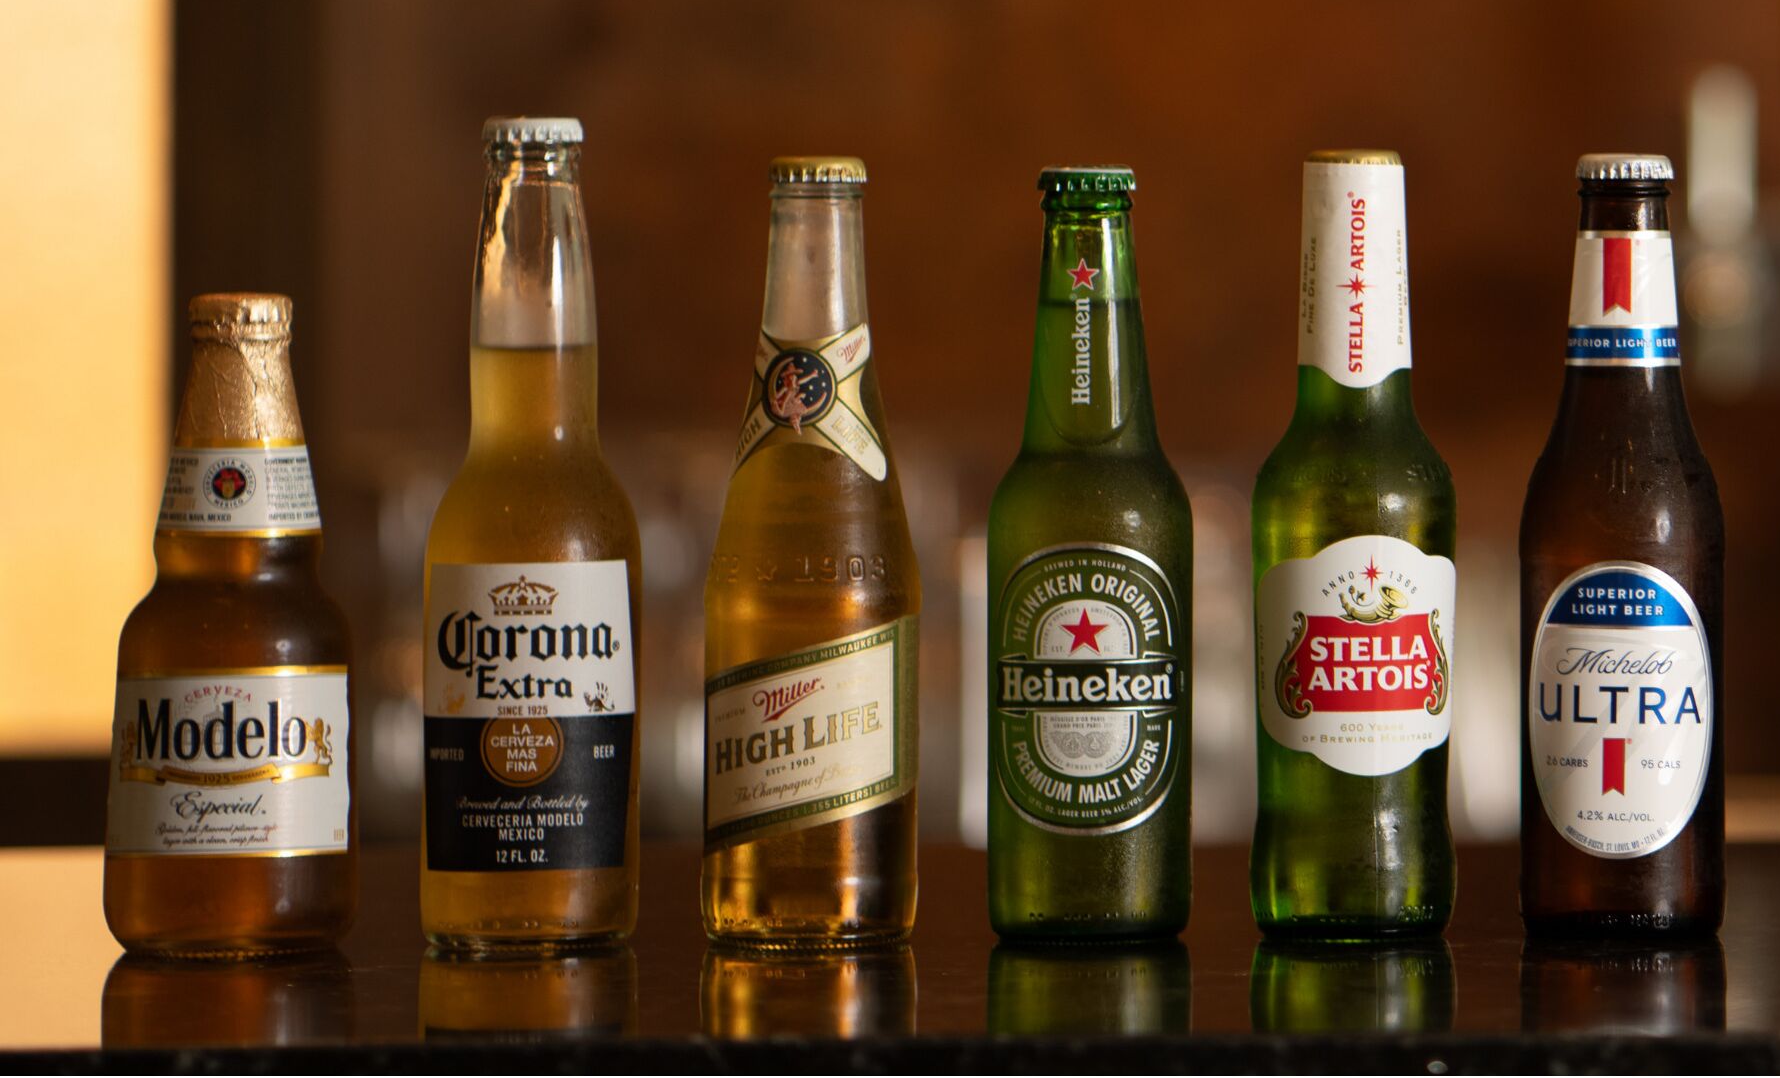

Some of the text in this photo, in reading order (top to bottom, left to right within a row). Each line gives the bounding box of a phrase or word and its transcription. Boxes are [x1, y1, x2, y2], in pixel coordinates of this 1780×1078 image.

[1348, 198, 1366, 374] STELLA ARTOIS
[1656, 338, 1676, 347] BEER
[1071, 297, 1090, 405] Heineken
[1091, 559, 1127, 572] HOLLAND
[1321, 571, 1355, 597] ANNO
[1577, 587, 1657, 599] SUPERIOR
[1012, 573, 1083, 642] HEINEKEN
[1090, 573, 1160, 642] ORIGINAL
[1571, 604, 1664, 616] LIGHT BEER
[438, 610, 613, 678] Corona
[819, 635, 878, 660] MILWAUKEE
[1310, 635, 1428, 661] STELLA
[1556, 647, 1673, 675] Michelob
[476, 664, 573, 700] Extra
[1002, 666, 1172, 702] Heineken
[1308, 664, 1429, 691] ARTOIS
[184, 685, 253, 705] CERVEZA
[752, 676, 822, 720] Miller
[497, 705, 549, 716] SINCE 1925
[1539, 682, 1702, 725] ULTRA
[136, 698, 308, 760] Modelo
[512, 723, 531, 734] LA
[1340, 722, 1364, 732] 600
[490, 735, 555, 748] CERVEZA
[715, 701, 880, 776] HIGH LIFE
[1319, 733, 1375, 744] BREWING
[506, 748, 537, 760] MAS
[593, 744, 615, 760] BEER
[506, 760, 538, 772] FINA
[790, 755, 816, 771] 1903
[1559, 757, 1588, 768] CARBS
[1640, 758, 1681, 770] 95 CALS
[203, 774, 231, 785] 1925
[1014, 739, 1160, 804] PREMIUM MALT LAGER
[751, 775, 812, 801] Champagne
[500, 796, 524, 810] and
[526, 795, 573, 810] Bottled
[575, 795, 591, 812] by
[462, 813, 584, 828] CERVECERIA MODELO
[1058, 809, 1079, 818] LAGER
[1577, 810, 1604, 821] 4.2%
[499, 828, 545, 842] MEXICO
[1614, 843, 1630, 851] LOUIS
[496, 849, 549, 863] 12 FL. OZ.
